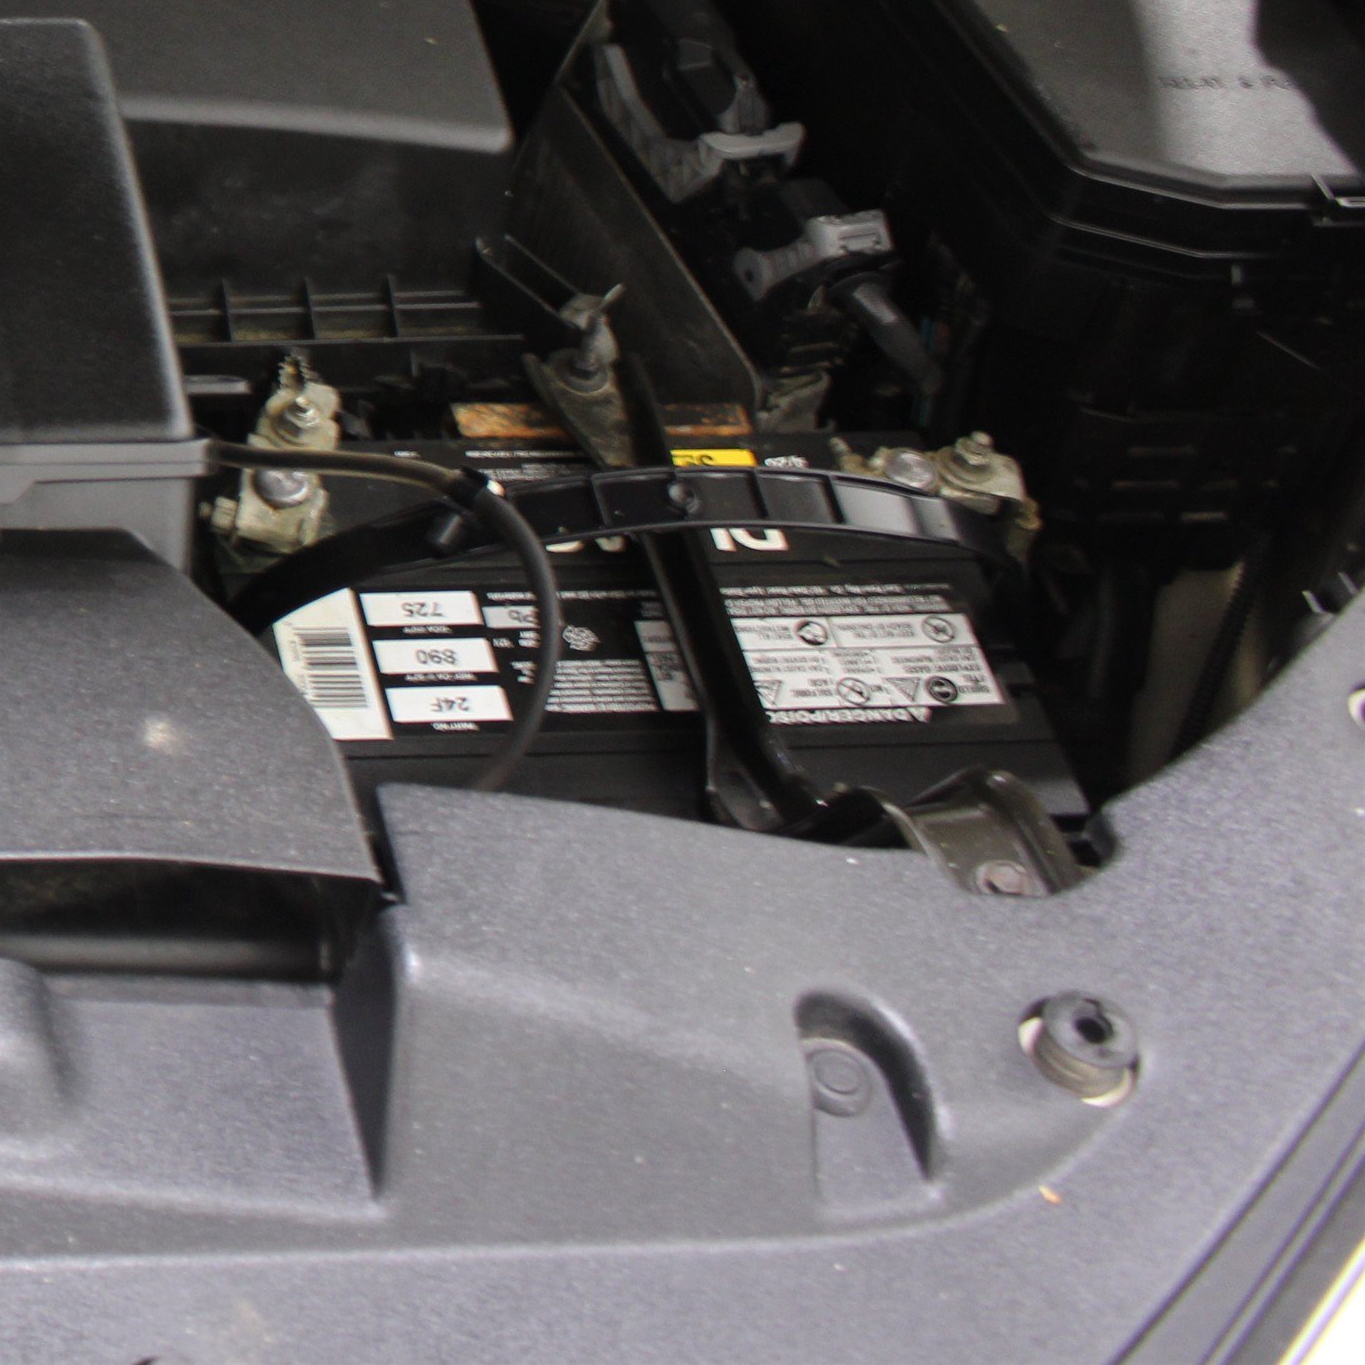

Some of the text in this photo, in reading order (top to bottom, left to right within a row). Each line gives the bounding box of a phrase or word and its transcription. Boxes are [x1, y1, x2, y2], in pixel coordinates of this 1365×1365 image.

[400, 601, 443, 619] 725
[415, 648, 457, 668] 890
[429, 696, 471, 714] 24F
